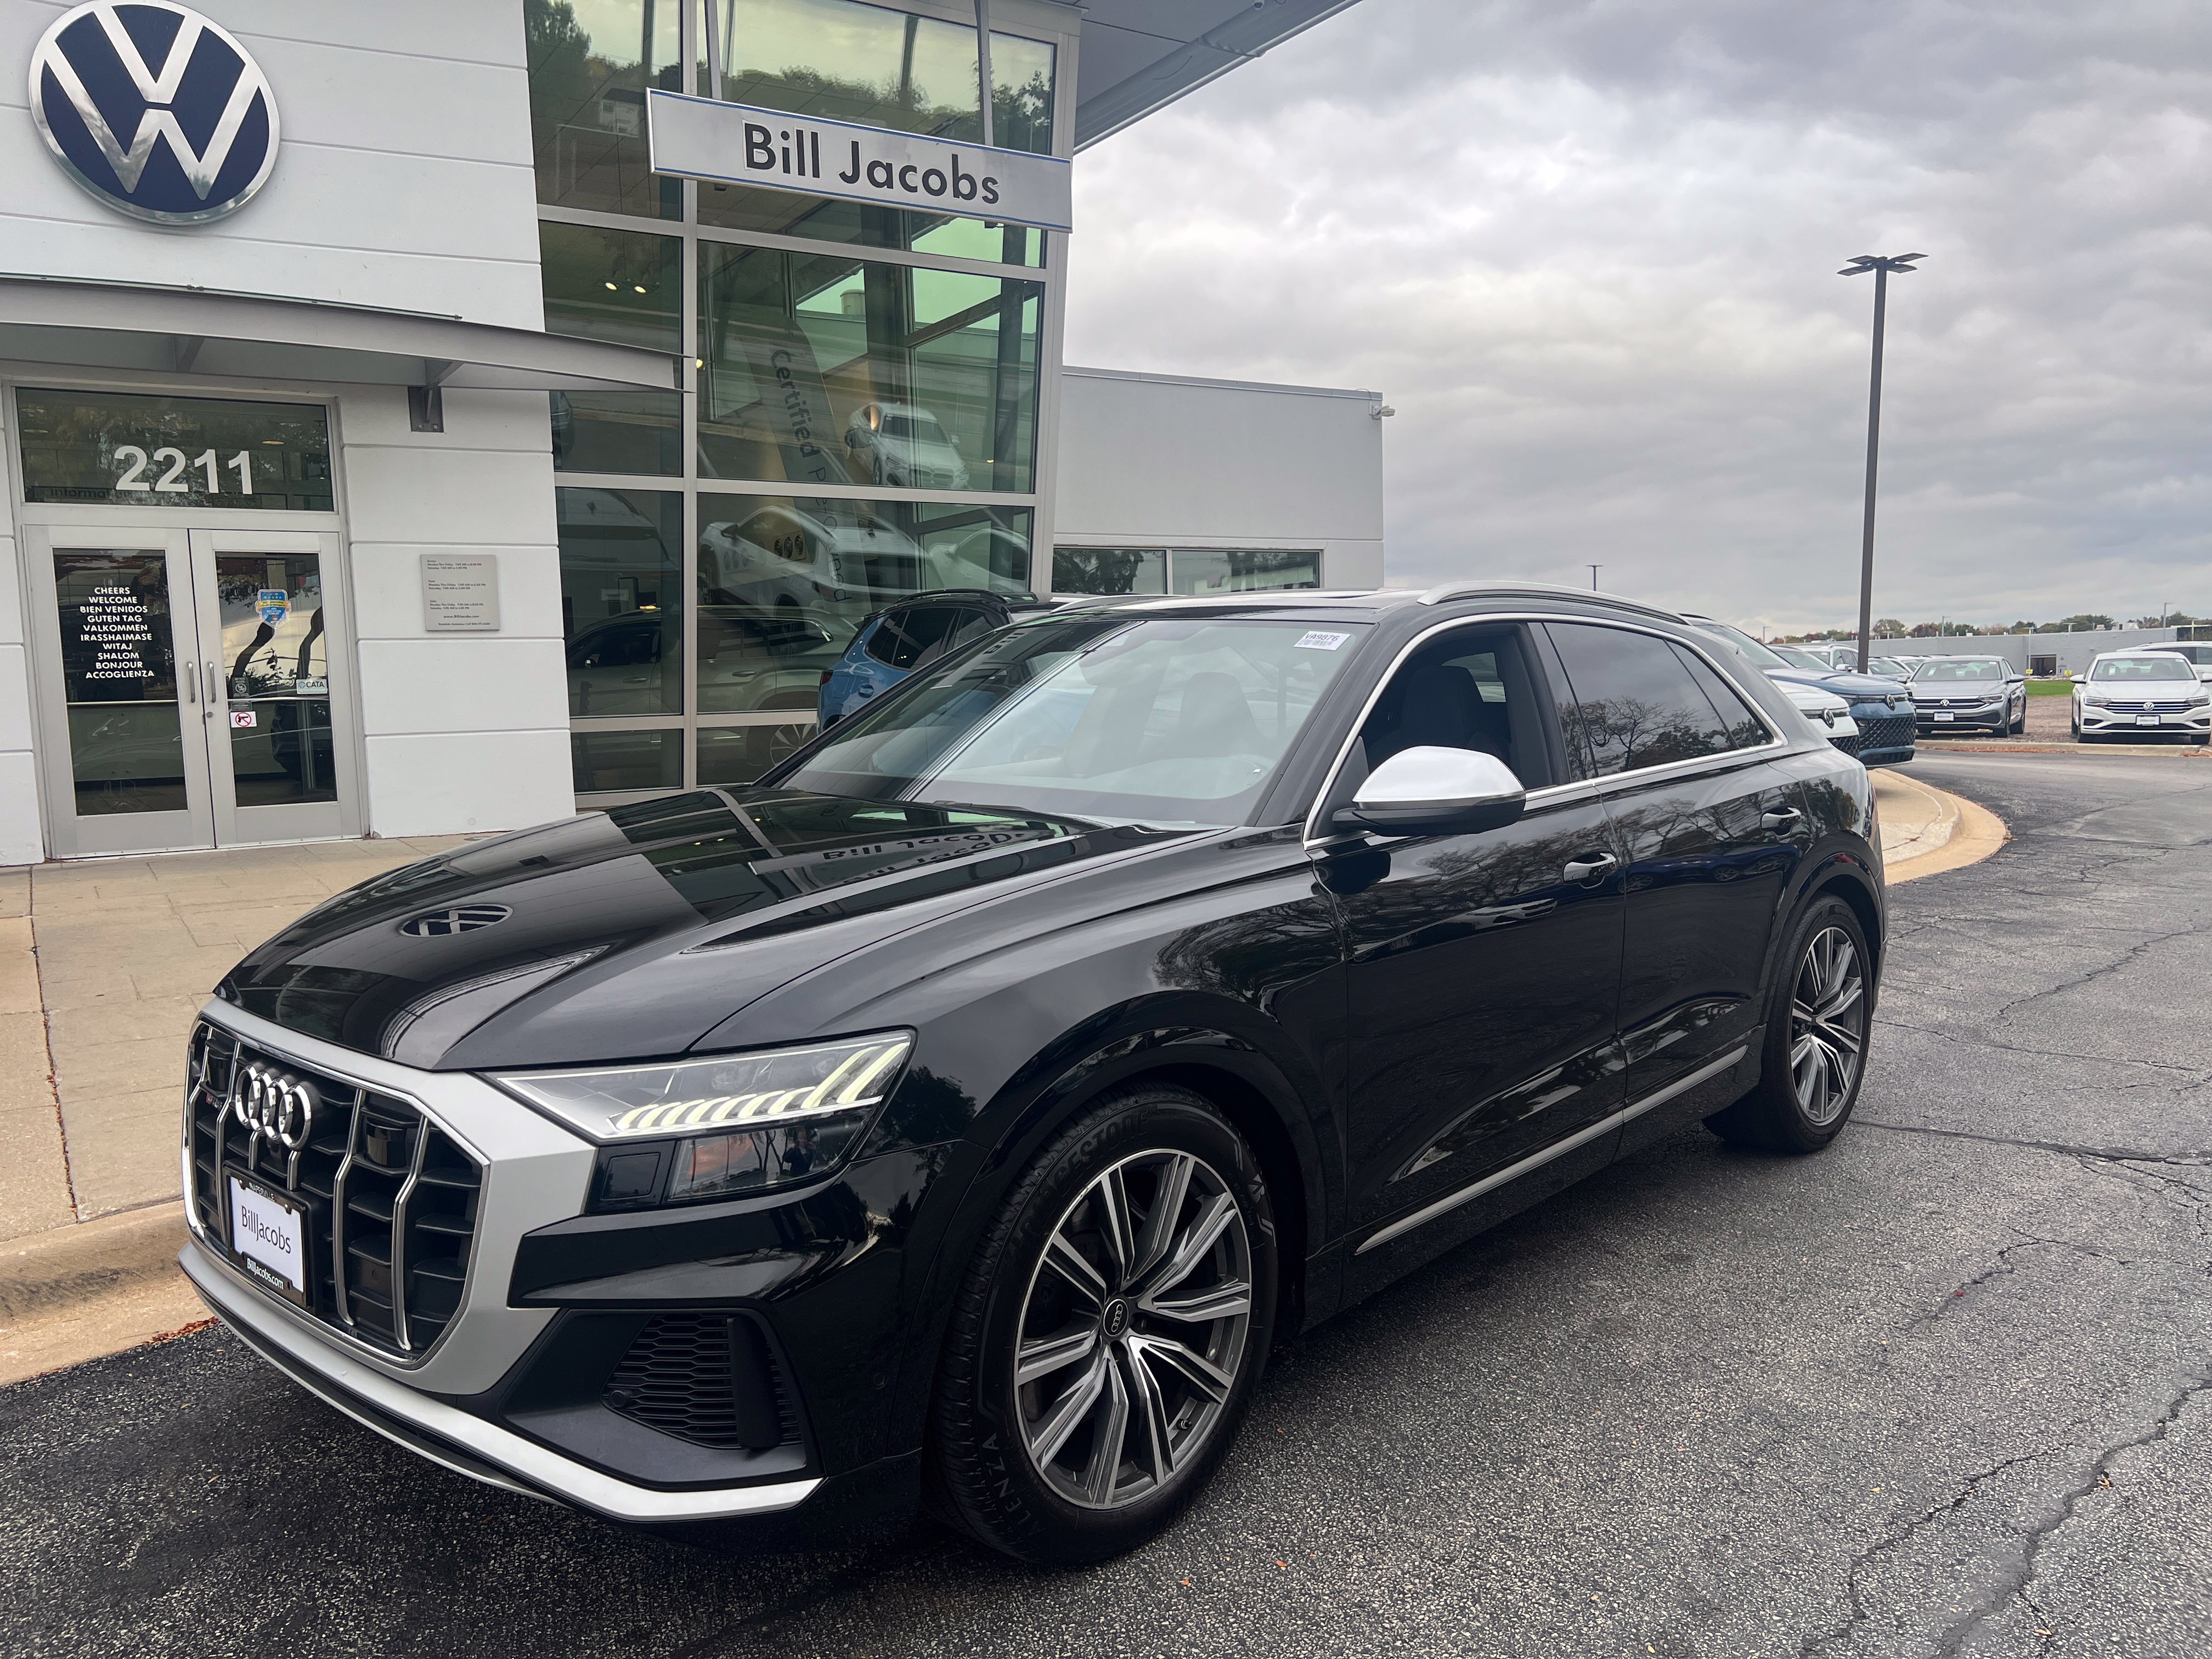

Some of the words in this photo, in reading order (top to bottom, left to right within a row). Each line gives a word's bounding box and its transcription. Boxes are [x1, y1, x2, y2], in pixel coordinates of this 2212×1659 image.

[744, 122, 821, 179] Bill
[838, 140, 1000, 205] Jacobs
[771, 349, 821, 458] Certified
[114, 445, 253, 495] 2211
[105, 605, 148, 613] VENIDOS
[83, 624, 148, 632] VALKOMMEN
[80, 633, 153, 641] IRASSHAIMASE
[1305, 633, 1340, 641] VA9876
[97, 652, 139, 660] SHALOM
[95, 661, 143, 669] BONJOUR
[86, 670, 155, 679] ACCOGLIENZA
[241, 1205, 291, 1255] BillJacobs
[247, 1257, 284, 1290] BillJacobs.com
